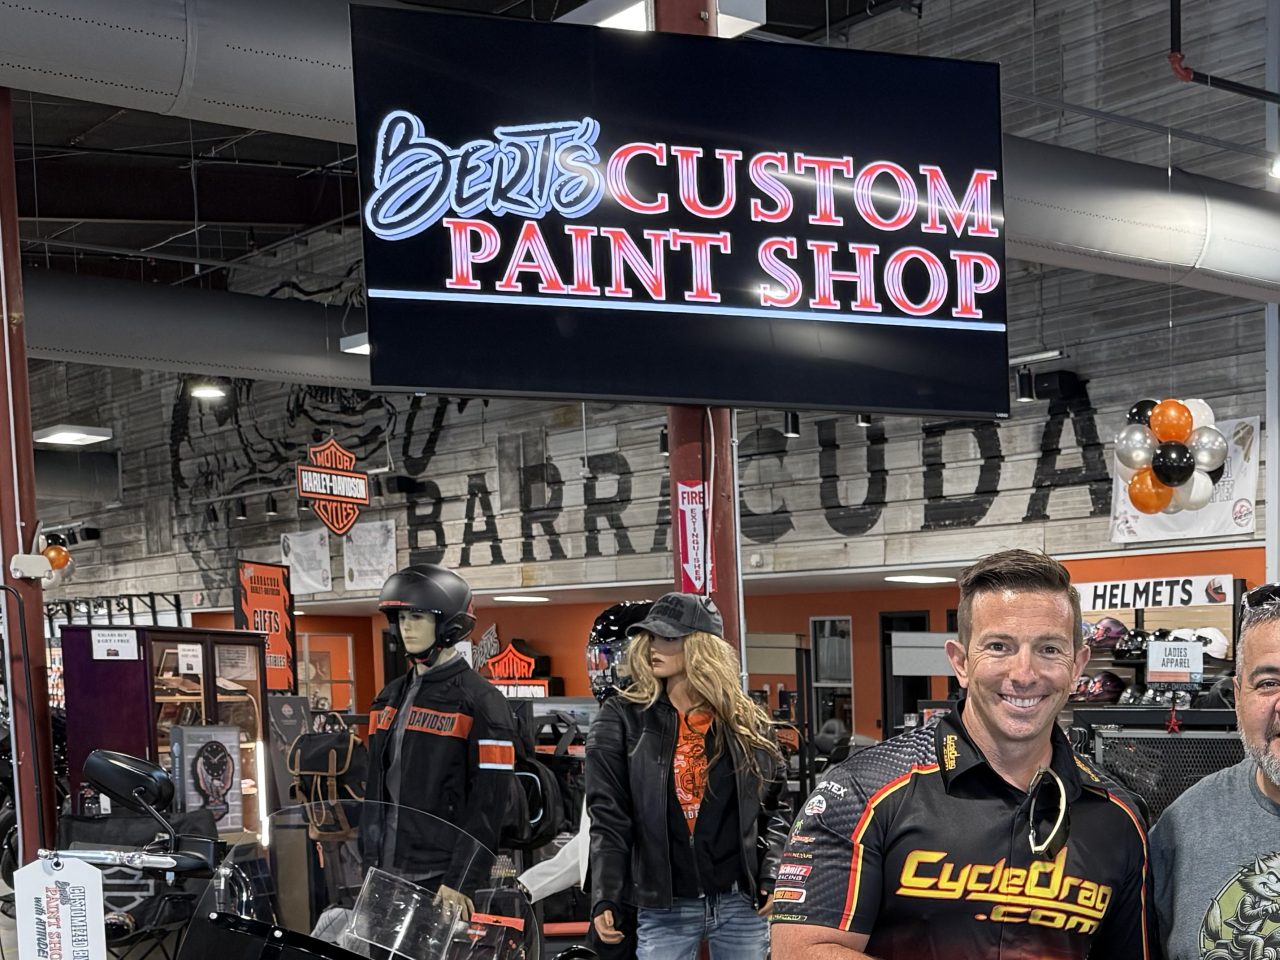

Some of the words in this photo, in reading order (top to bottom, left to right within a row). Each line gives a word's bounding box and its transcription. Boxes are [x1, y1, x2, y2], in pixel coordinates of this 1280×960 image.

[607, 142, 999, 239] CUSTOM
[443, 217, 731, 303] PAINT
[757, 236, 1000, 319] SHOP
[316, 444, 350, 471] MOTOR
[402, 369, 1112, 568] BARRCUDA
[302, 470, 367, 499] HARLEY-DAVIDSON
[681, 491, 704, 506] FIRE
[319, 500, 353, 529] CYCLES
[690, 508, 702, 581] EXTINGUISHER
[1092, 579, 1193, 610] HELMETS
[253, 609, 280, 633] GIFTS
[494, 650, 529, 679] MOTOR
[1161, 658, 1190, 669] APPAREL
[1164, 647, 1188, 658] LADIES
[408, 710, 457, 733] DAVIDSON
[896, 847, 1113, 918] CycleDrag
[34, 896, 47, 915] with
[45, 887, 61, 929] PAINT
[69, 886, 88, 948] CUSTOMIZED
